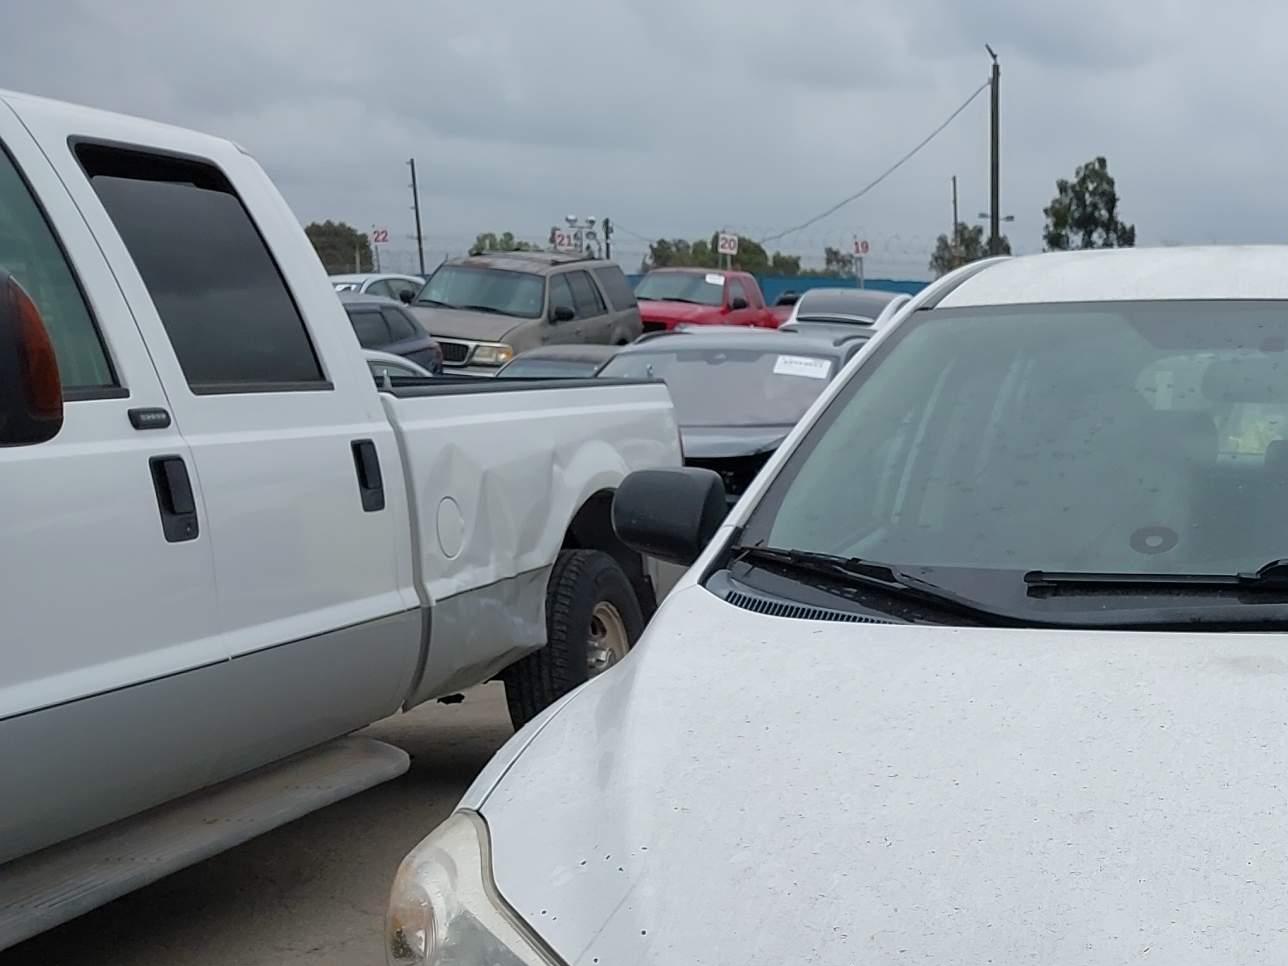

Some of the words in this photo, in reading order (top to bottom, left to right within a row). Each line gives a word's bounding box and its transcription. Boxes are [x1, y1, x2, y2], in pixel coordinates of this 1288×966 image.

[373, 230, 389, 243] 22
[556, 233, 572, 247] 21
[720, 236, 737, 250] 20
[853, 240, 869, 254] 19
